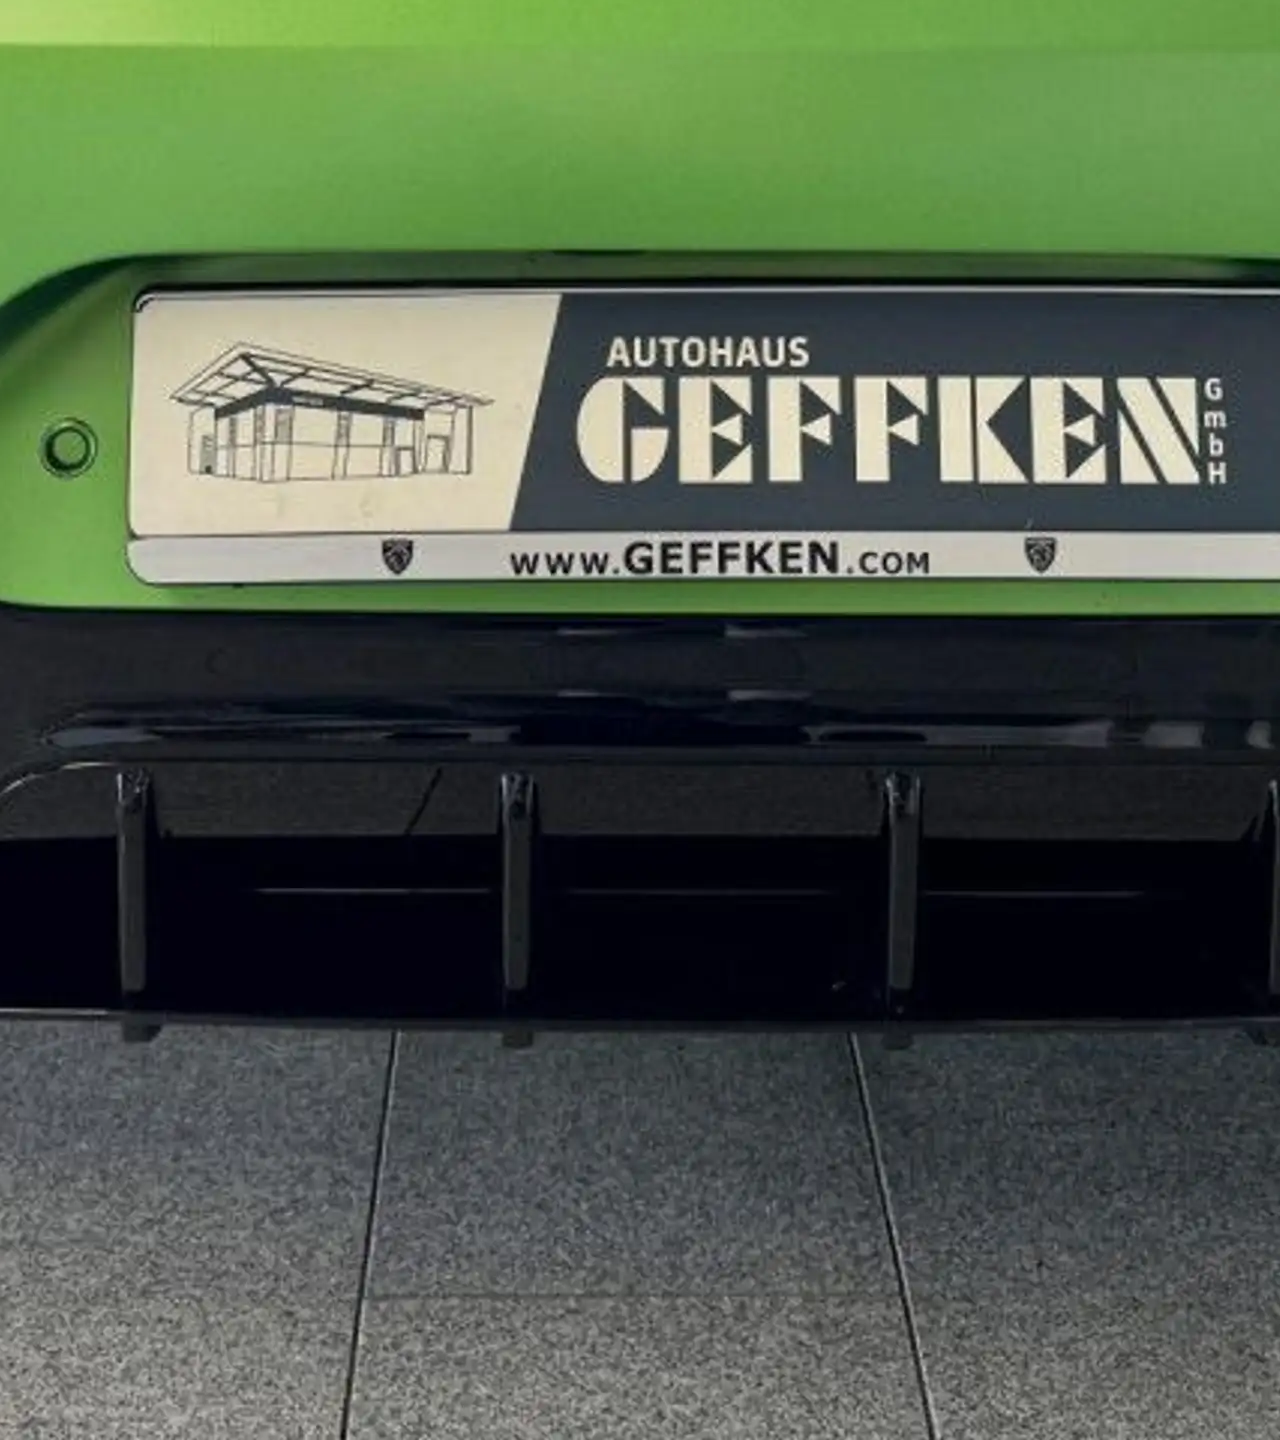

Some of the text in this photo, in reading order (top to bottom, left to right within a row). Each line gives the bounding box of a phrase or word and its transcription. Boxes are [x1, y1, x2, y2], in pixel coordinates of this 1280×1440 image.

[606, 336, 810, 368] AUTOHAUS
[576, 375, 1201, 484] GEFFKEN
[1203, 377, 1228, 485] GmbH
